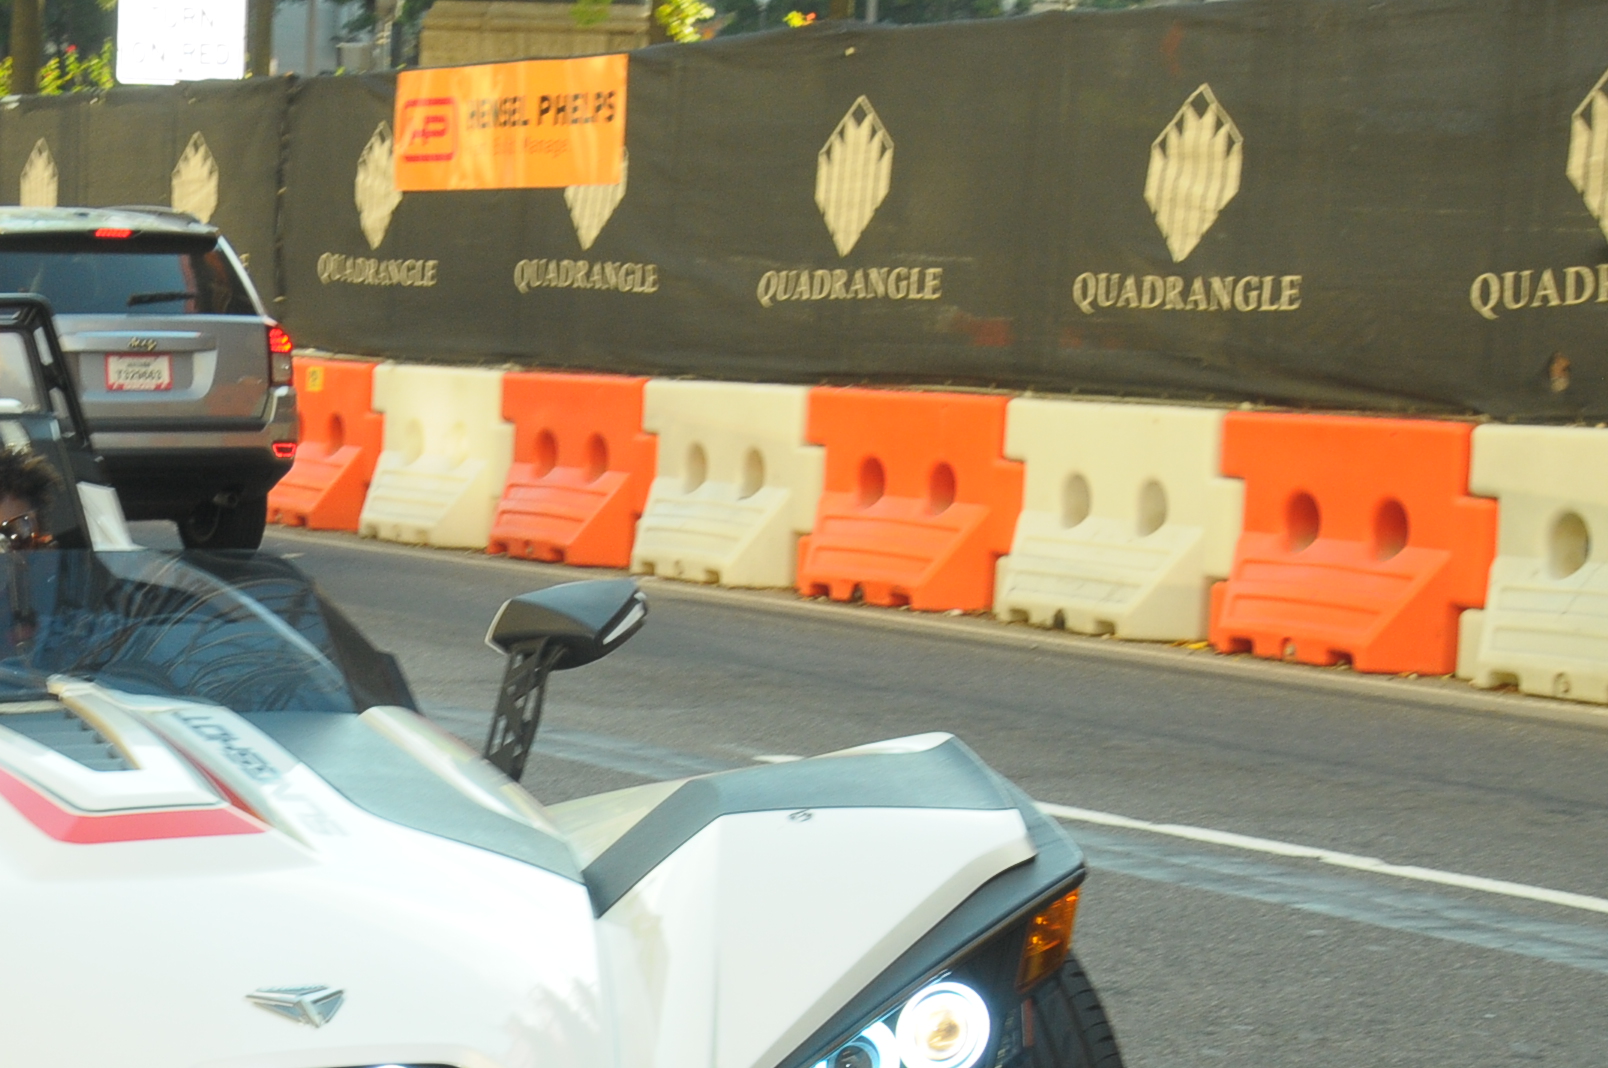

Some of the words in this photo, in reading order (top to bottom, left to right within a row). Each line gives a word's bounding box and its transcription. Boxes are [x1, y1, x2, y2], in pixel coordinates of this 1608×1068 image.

[149, 6, 214, 28] TURN
[132, 40, 165, 64] ON
[183, 42, 230, 65] RED
[537, 90, 617, 127] PHELPS
[317, 251, 438, 286] QUADRANGLE
[514, 258, 659, 294] QUADRANGLE
[756, 266, 944, 308] QUADRANGLE
[1072, 271, 1302, 314] QUADRANGLE
